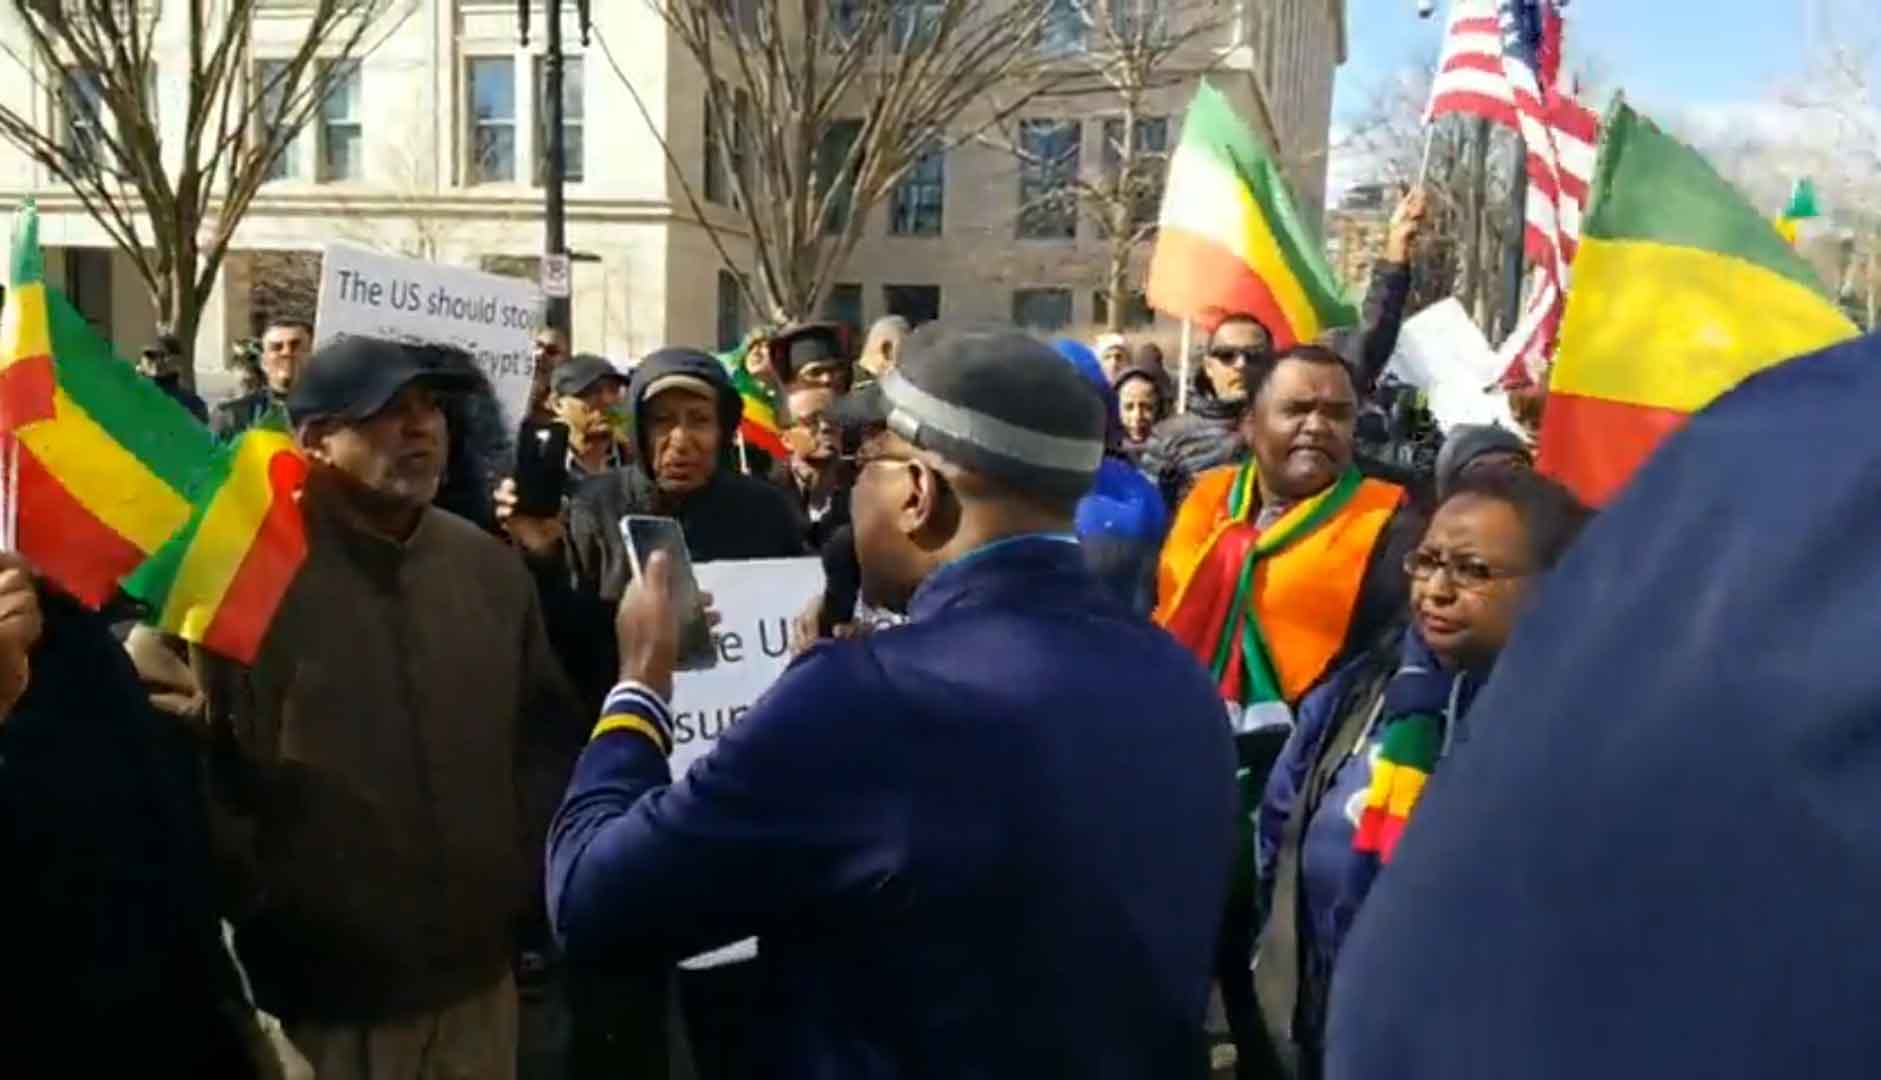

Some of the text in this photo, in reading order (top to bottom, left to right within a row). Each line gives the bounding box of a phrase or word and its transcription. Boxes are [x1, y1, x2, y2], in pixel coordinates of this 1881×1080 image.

[337, 270, 535, 333] The US should sto
